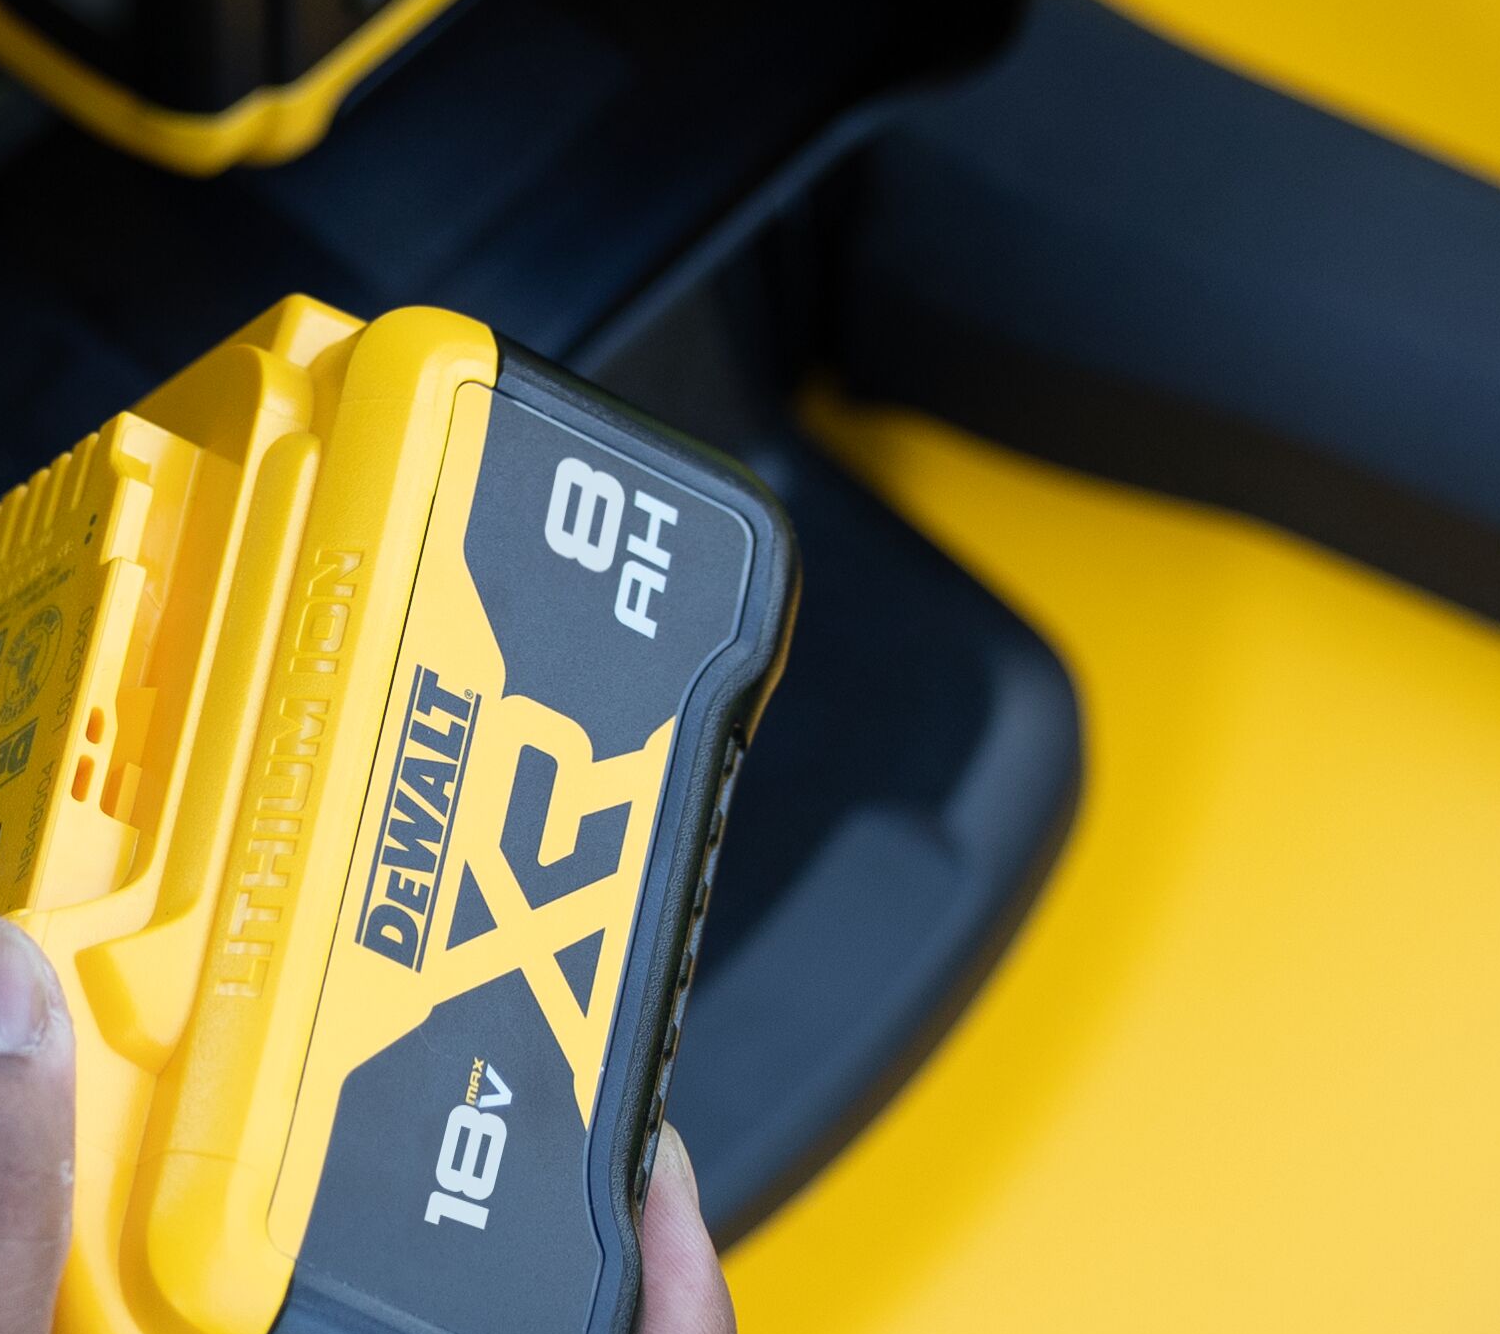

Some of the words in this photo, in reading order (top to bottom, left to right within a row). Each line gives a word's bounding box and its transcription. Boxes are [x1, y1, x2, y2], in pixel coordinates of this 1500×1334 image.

[546, 457, 624, 573] 8
[614, 493, 677, 638] AH
[216, 696, 333, 1000] LITHIUM
[294, 547, 366, 677] ION
[428, 696, 675, 1130] XR
